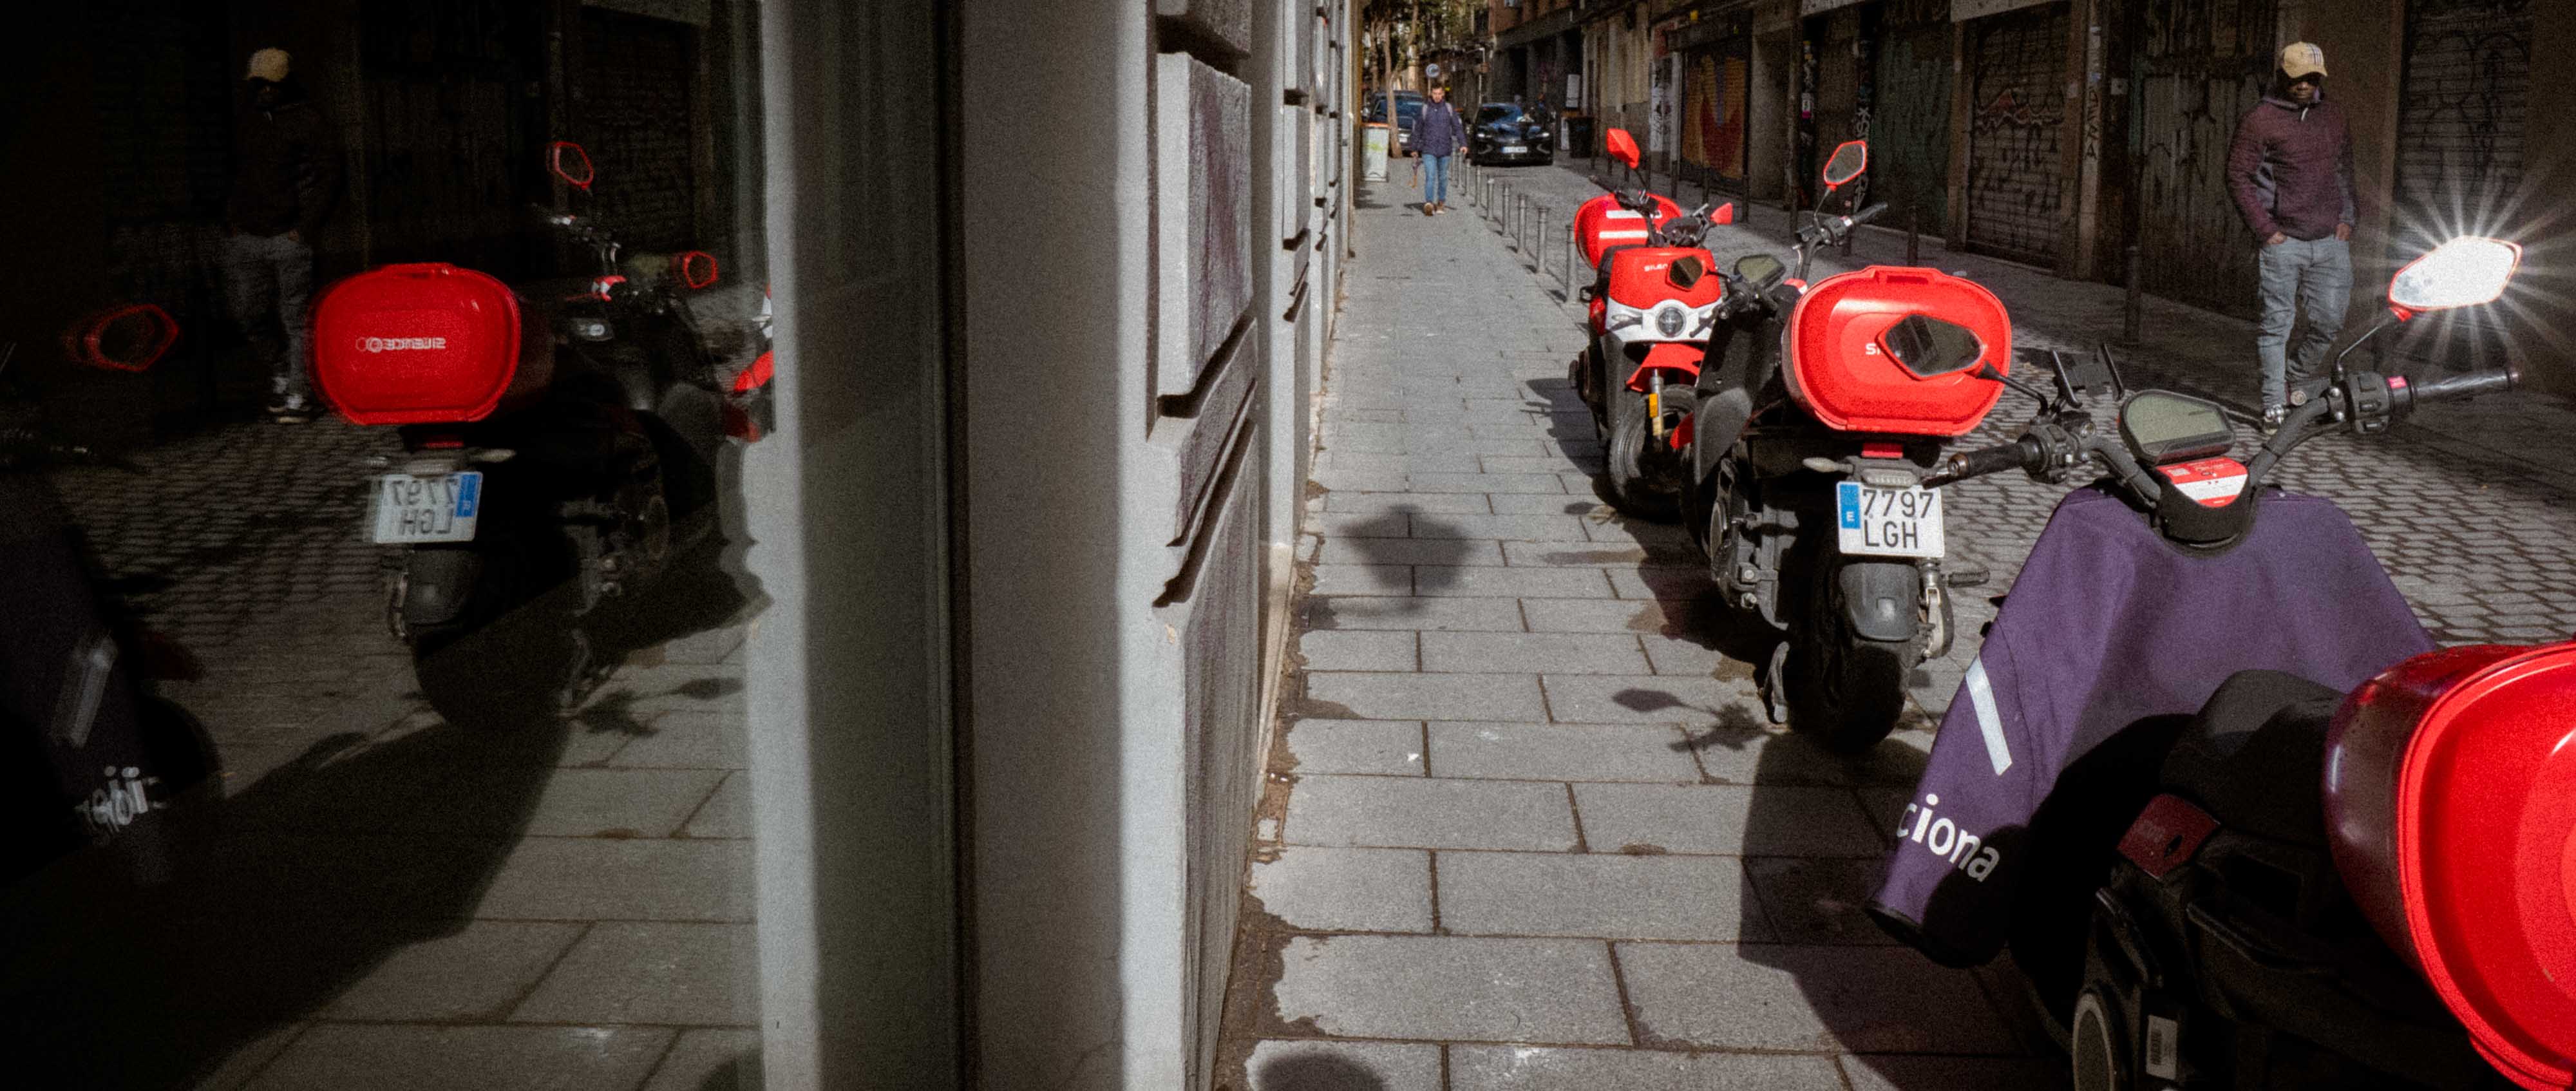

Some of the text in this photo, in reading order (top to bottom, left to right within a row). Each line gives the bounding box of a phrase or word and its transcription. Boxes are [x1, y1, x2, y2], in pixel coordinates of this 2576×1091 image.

[1846, 511, 1855, 522] E
[1863, 489, 1934, 518] 7797
[1864, 519, 1918, 549] LGH
